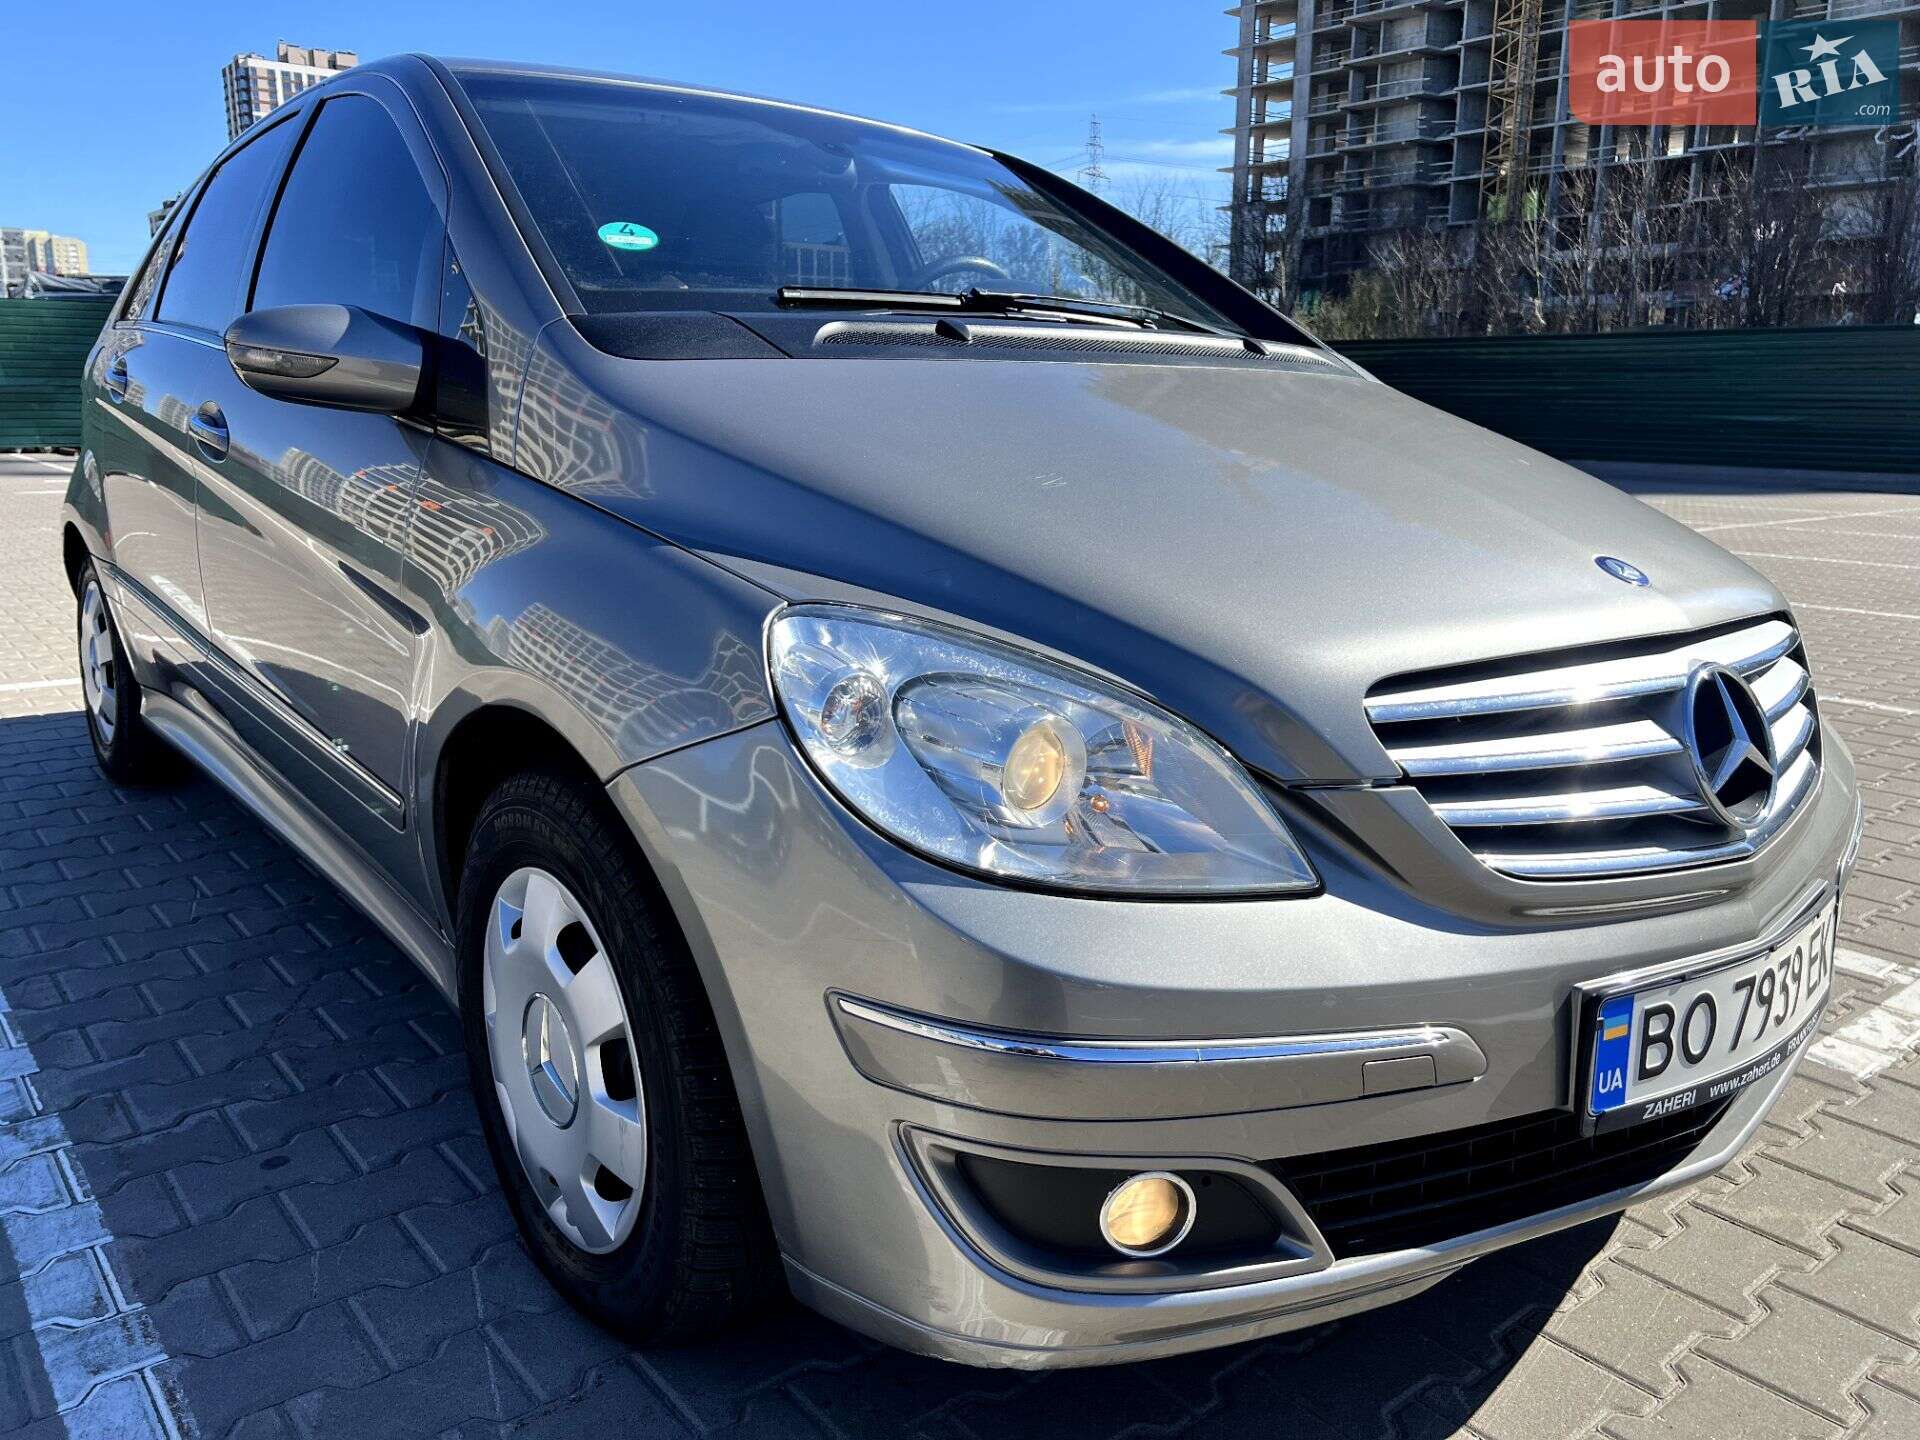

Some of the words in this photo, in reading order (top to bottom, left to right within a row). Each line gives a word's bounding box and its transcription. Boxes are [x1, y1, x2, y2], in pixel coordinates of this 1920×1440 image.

[619, 223, 635, 236] 4
[1638, 992, 1717, 1081] BO
[1729, 945, 1803, 1051] 7939
[1598, 1067, 1623, 1094] UA
[1642, 1089, 1697, 1120] ZAHERI
[1709, 1052, 1781, 1098] www.zaheri.de
